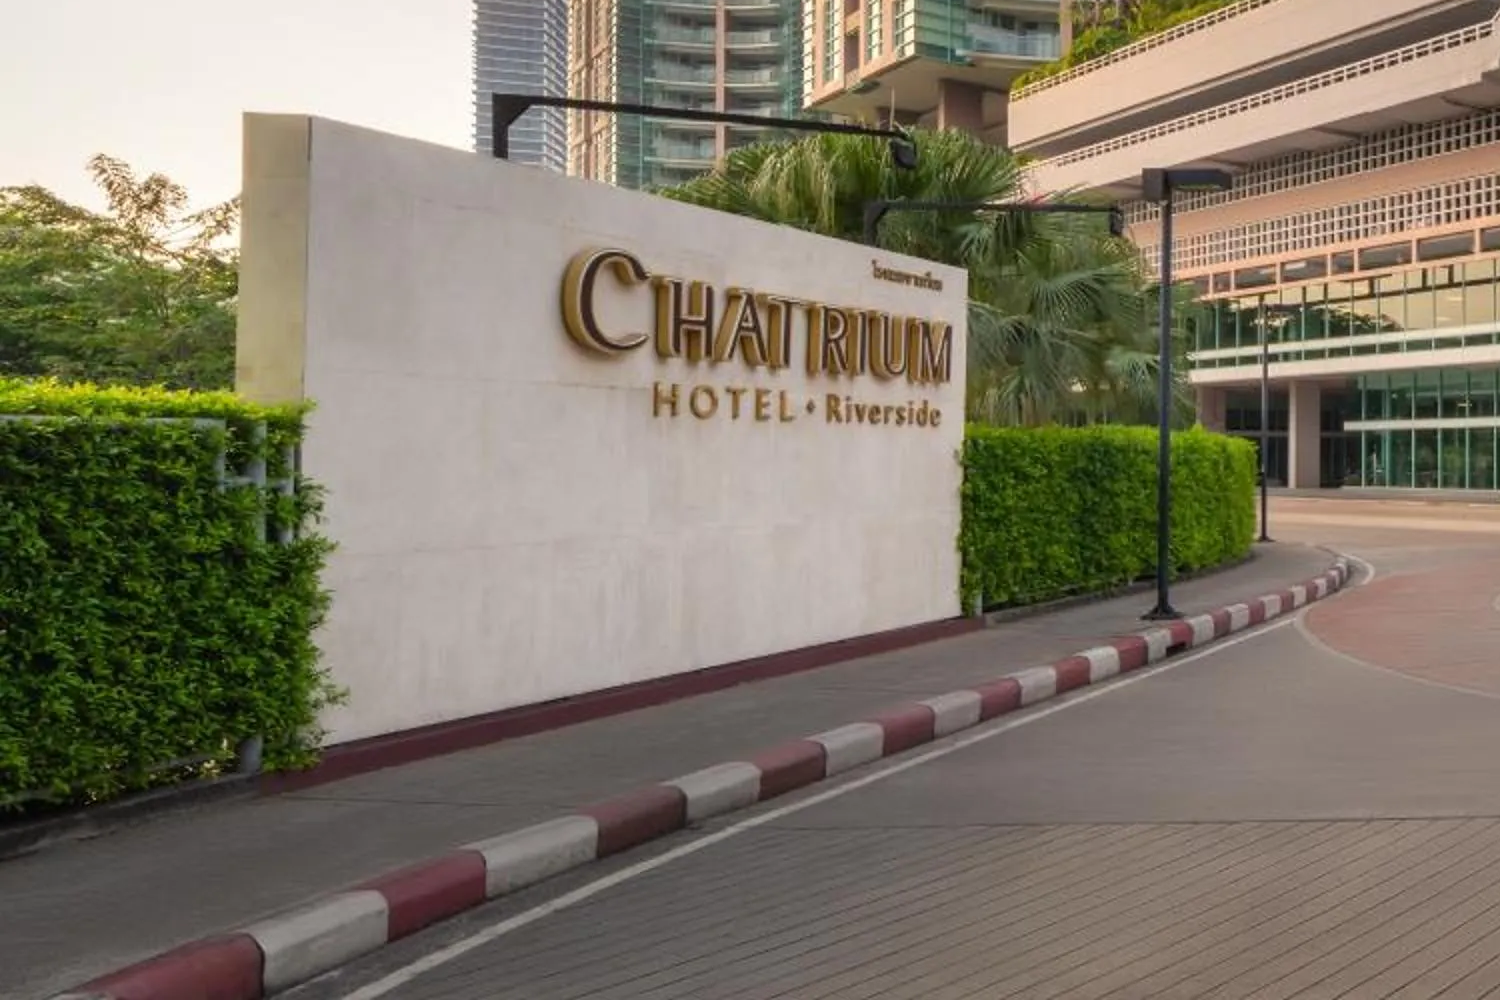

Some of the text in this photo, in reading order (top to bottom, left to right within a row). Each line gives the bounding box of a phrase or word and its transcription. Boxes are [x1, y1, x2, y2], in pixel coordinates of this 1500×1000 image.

[561, 247, 953, 385] CHATRIUM
[652, 381, 942, 427] HOTEL Riverside
